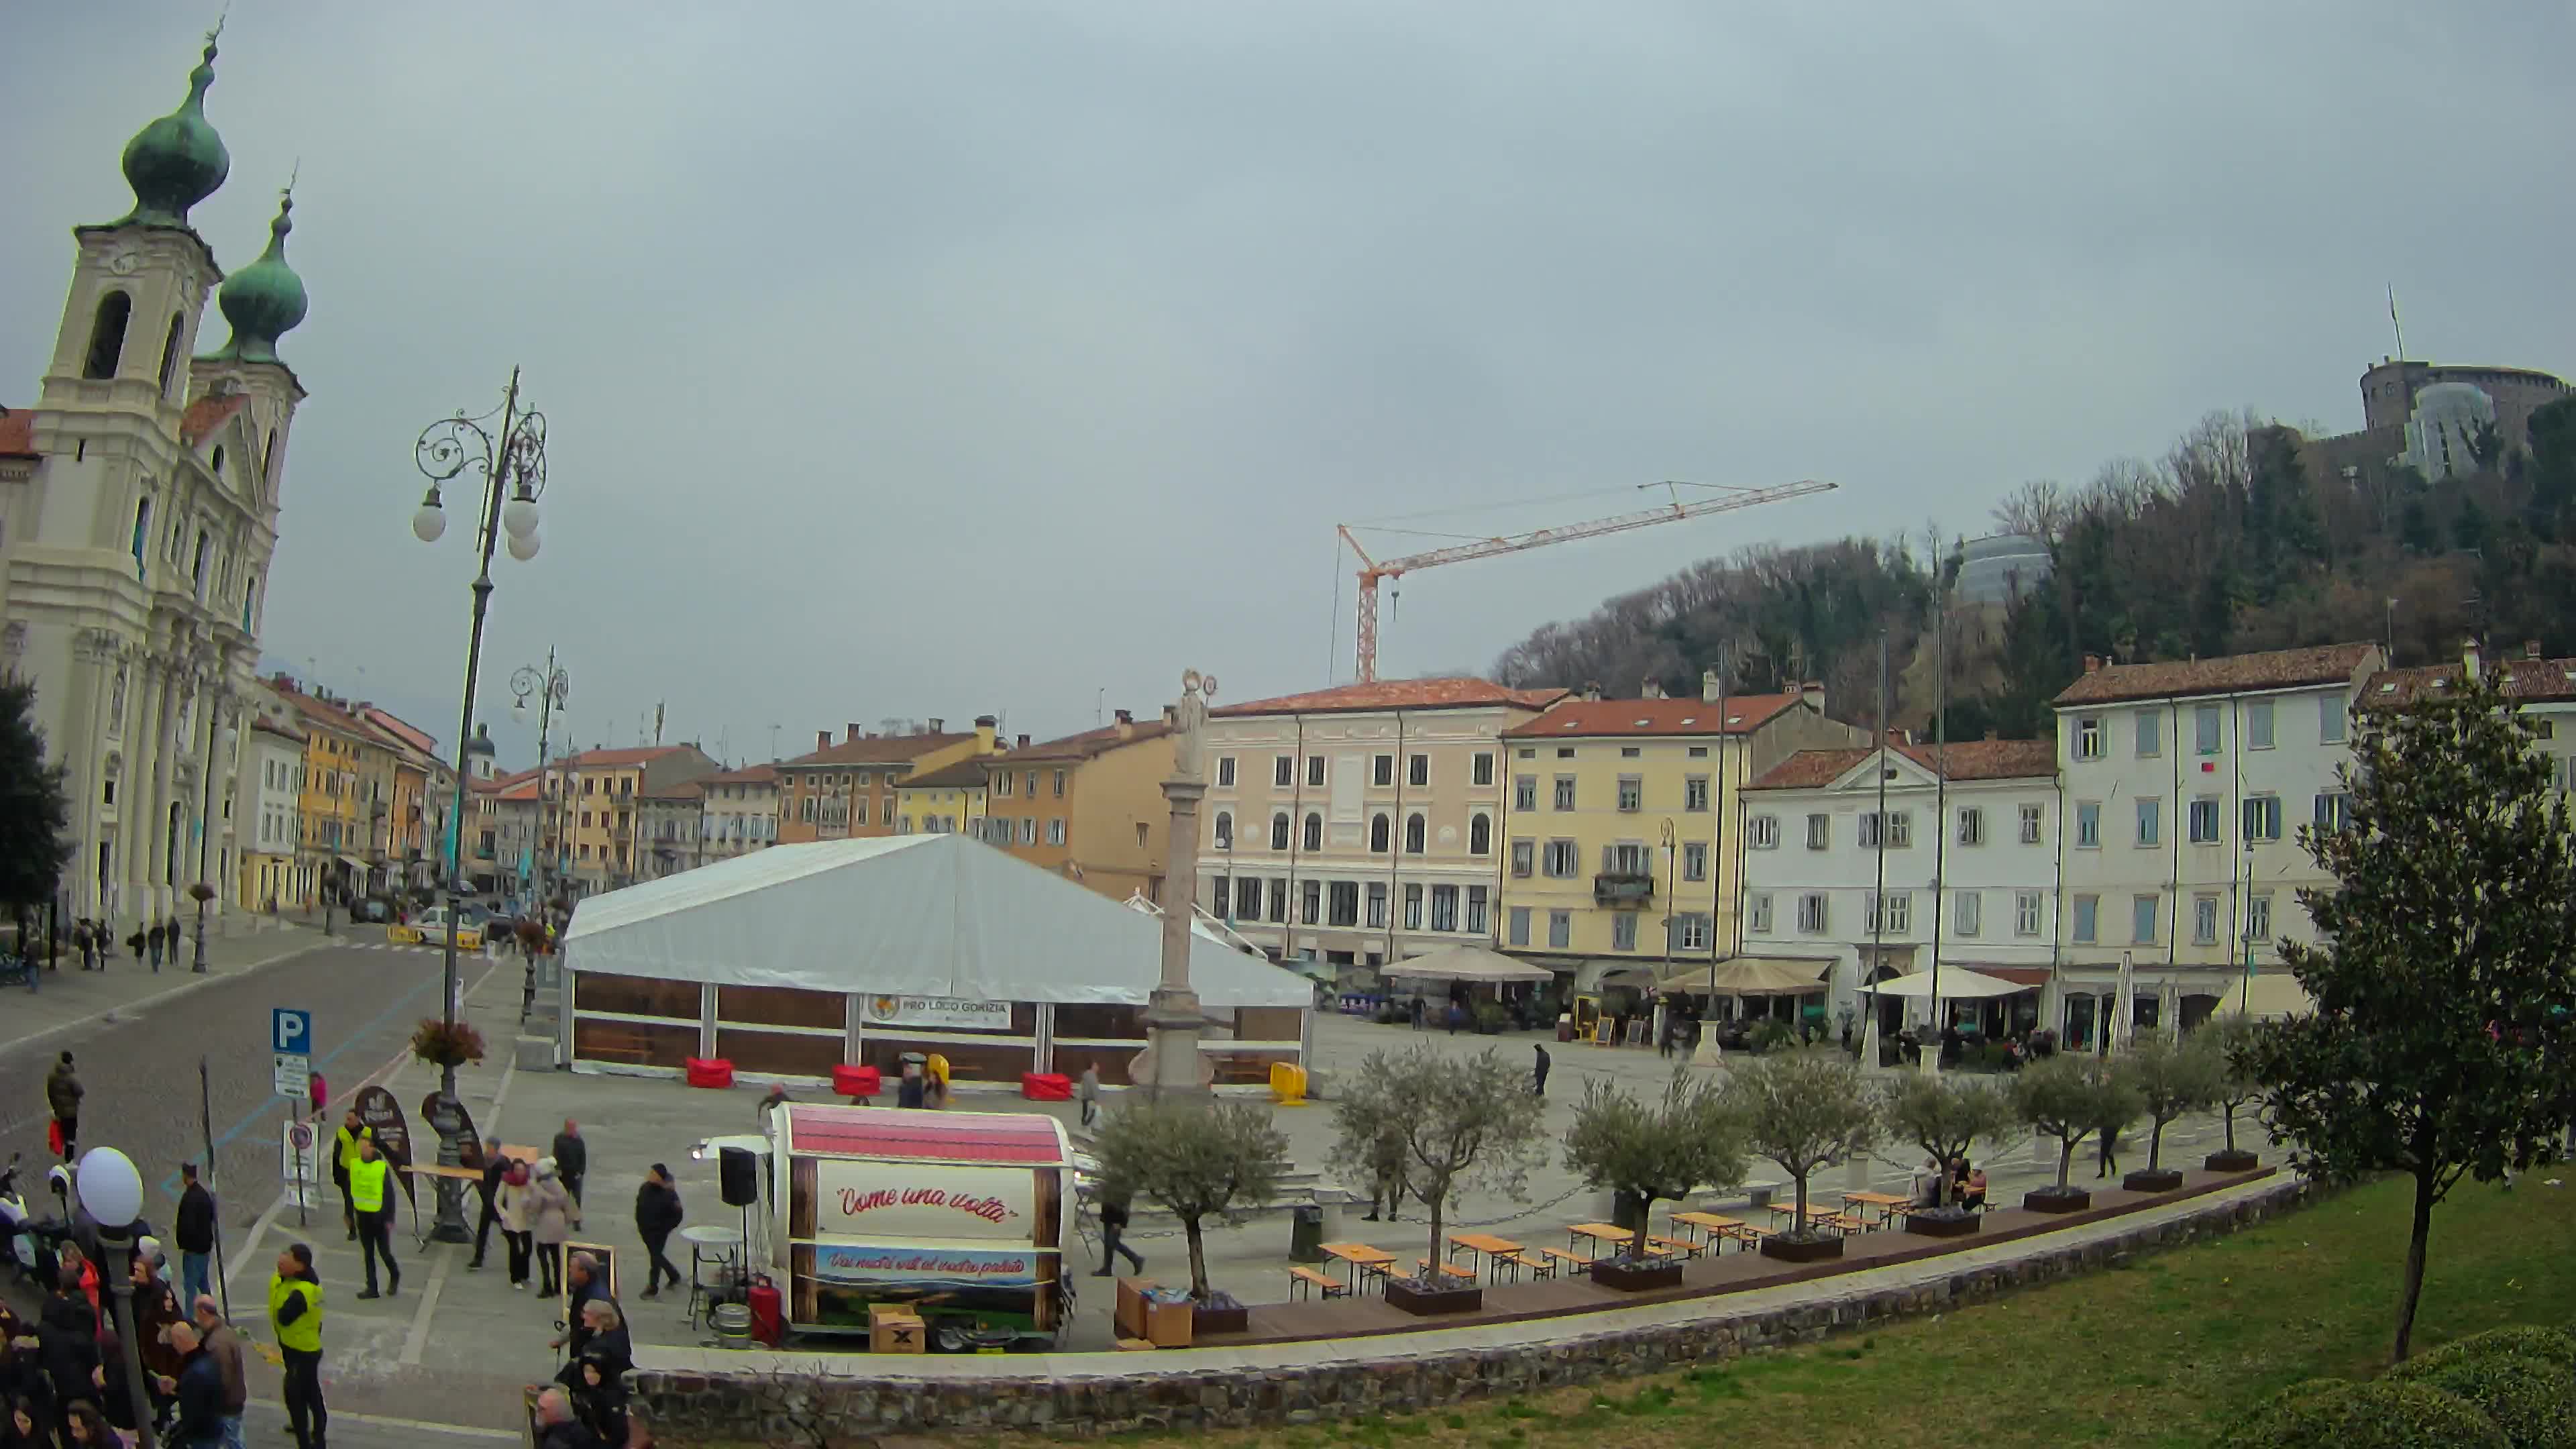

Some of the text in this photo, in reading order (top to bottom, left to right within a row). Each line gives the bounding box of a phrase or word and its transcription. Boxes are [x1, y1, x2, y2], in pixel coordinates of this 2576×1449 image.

[903, 1000, 1006, 1014] PRO LOCO GORIZIA
[279, 1012, 303, 1047] P
[901, 1187, 946, 1206] una
